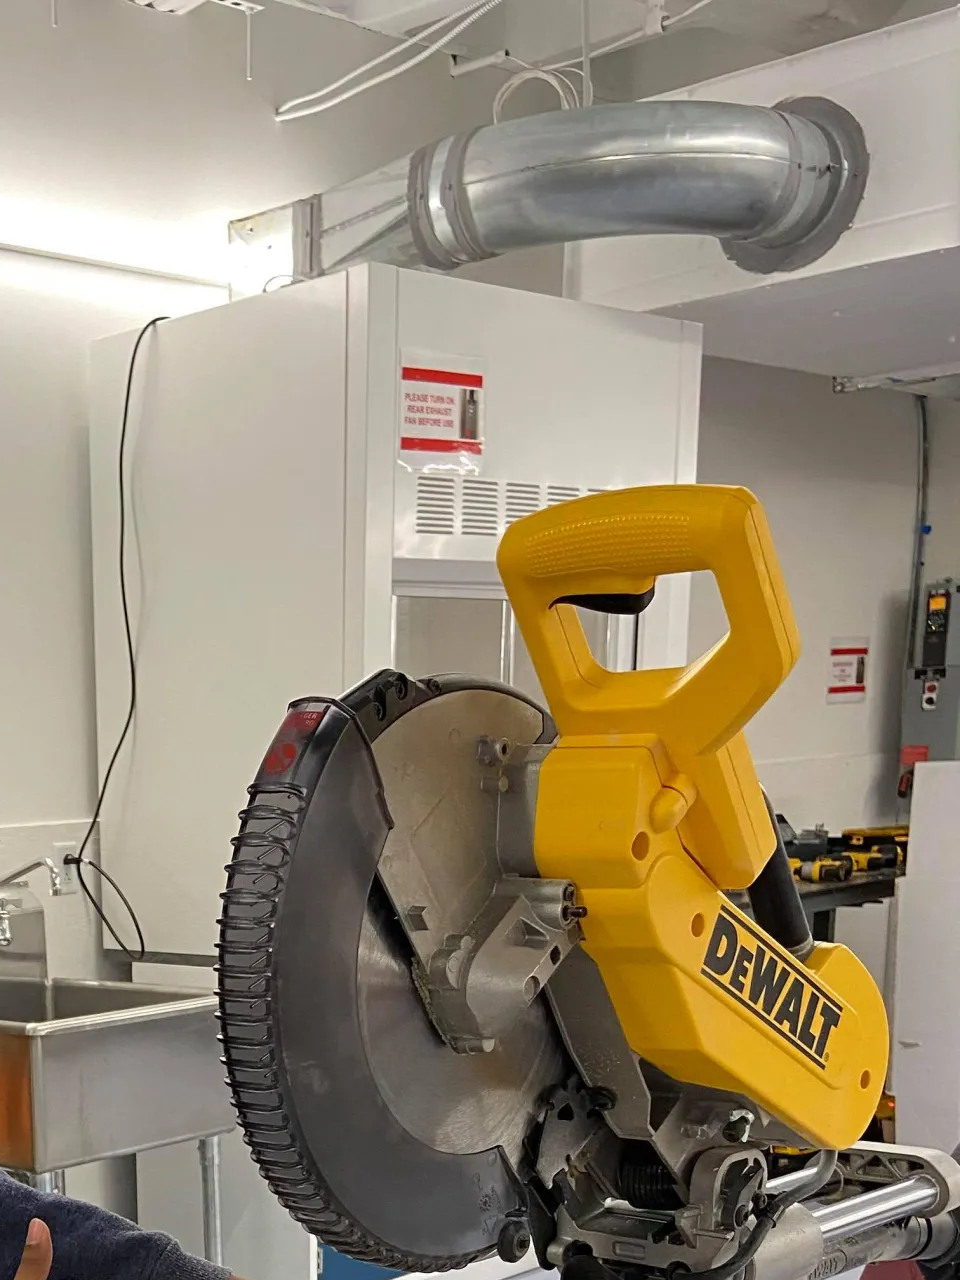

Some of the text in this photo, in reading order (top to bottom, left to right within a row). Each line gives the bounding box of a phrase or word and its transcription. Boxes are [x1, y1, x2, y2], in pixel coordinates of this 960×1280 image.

[404, 393, 455, 405] PLEASE TURN ON
[407, 404, 452, 416] REAR EXHAUST
[404, 416, 454, 428] FAN BEFORE USE
[703, 912, 842, 1059] DEWALT
